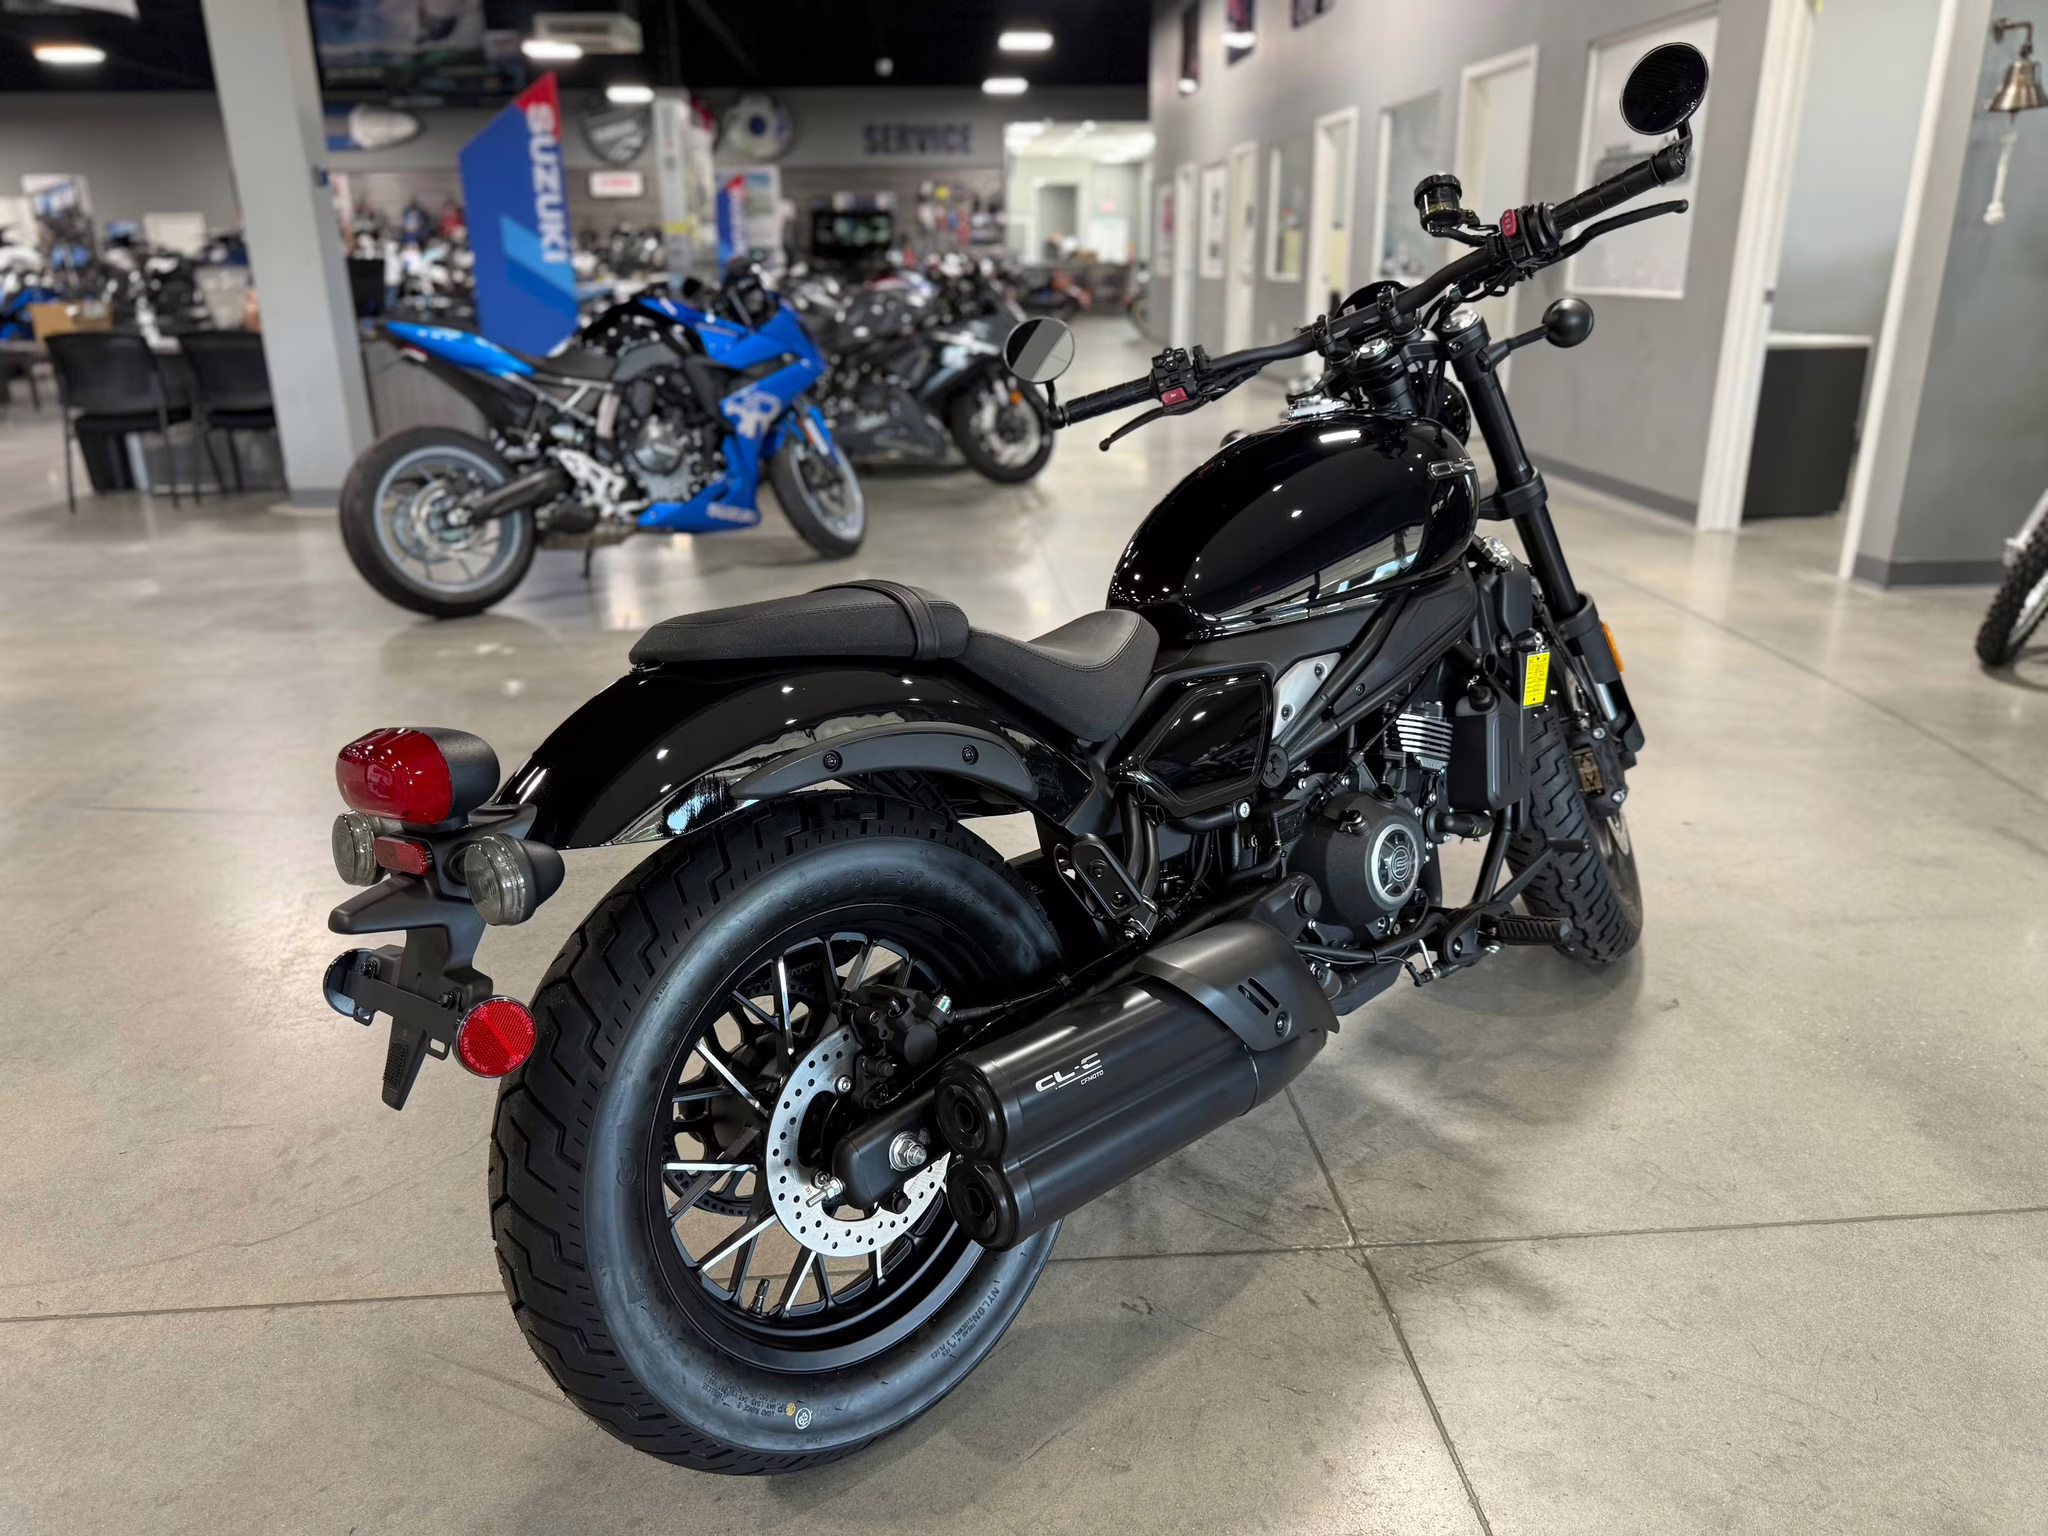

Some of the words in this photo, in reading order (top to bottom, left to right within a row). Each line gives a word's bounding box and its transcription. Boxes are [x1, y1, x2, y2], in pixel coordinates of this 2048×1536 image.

[864, 123, 972, 155] SERVICE
[526, 102, 569, 264] SUZUKI
[1081, 1070, 1104, 1085] CFMOTO
[971, 1286, 1000, 1323] NYLON
[951, 1317, 973, 1340] SIDEWALL
[962, 1322, 976, 1338] TREAD
[930, 1344, 946, 1359] PLIES
[942, 1342, 957, 1357] PLIES
[742, 1403, 759, 1415] RANGE
[760, 1409, 775, 1417] LOAD
